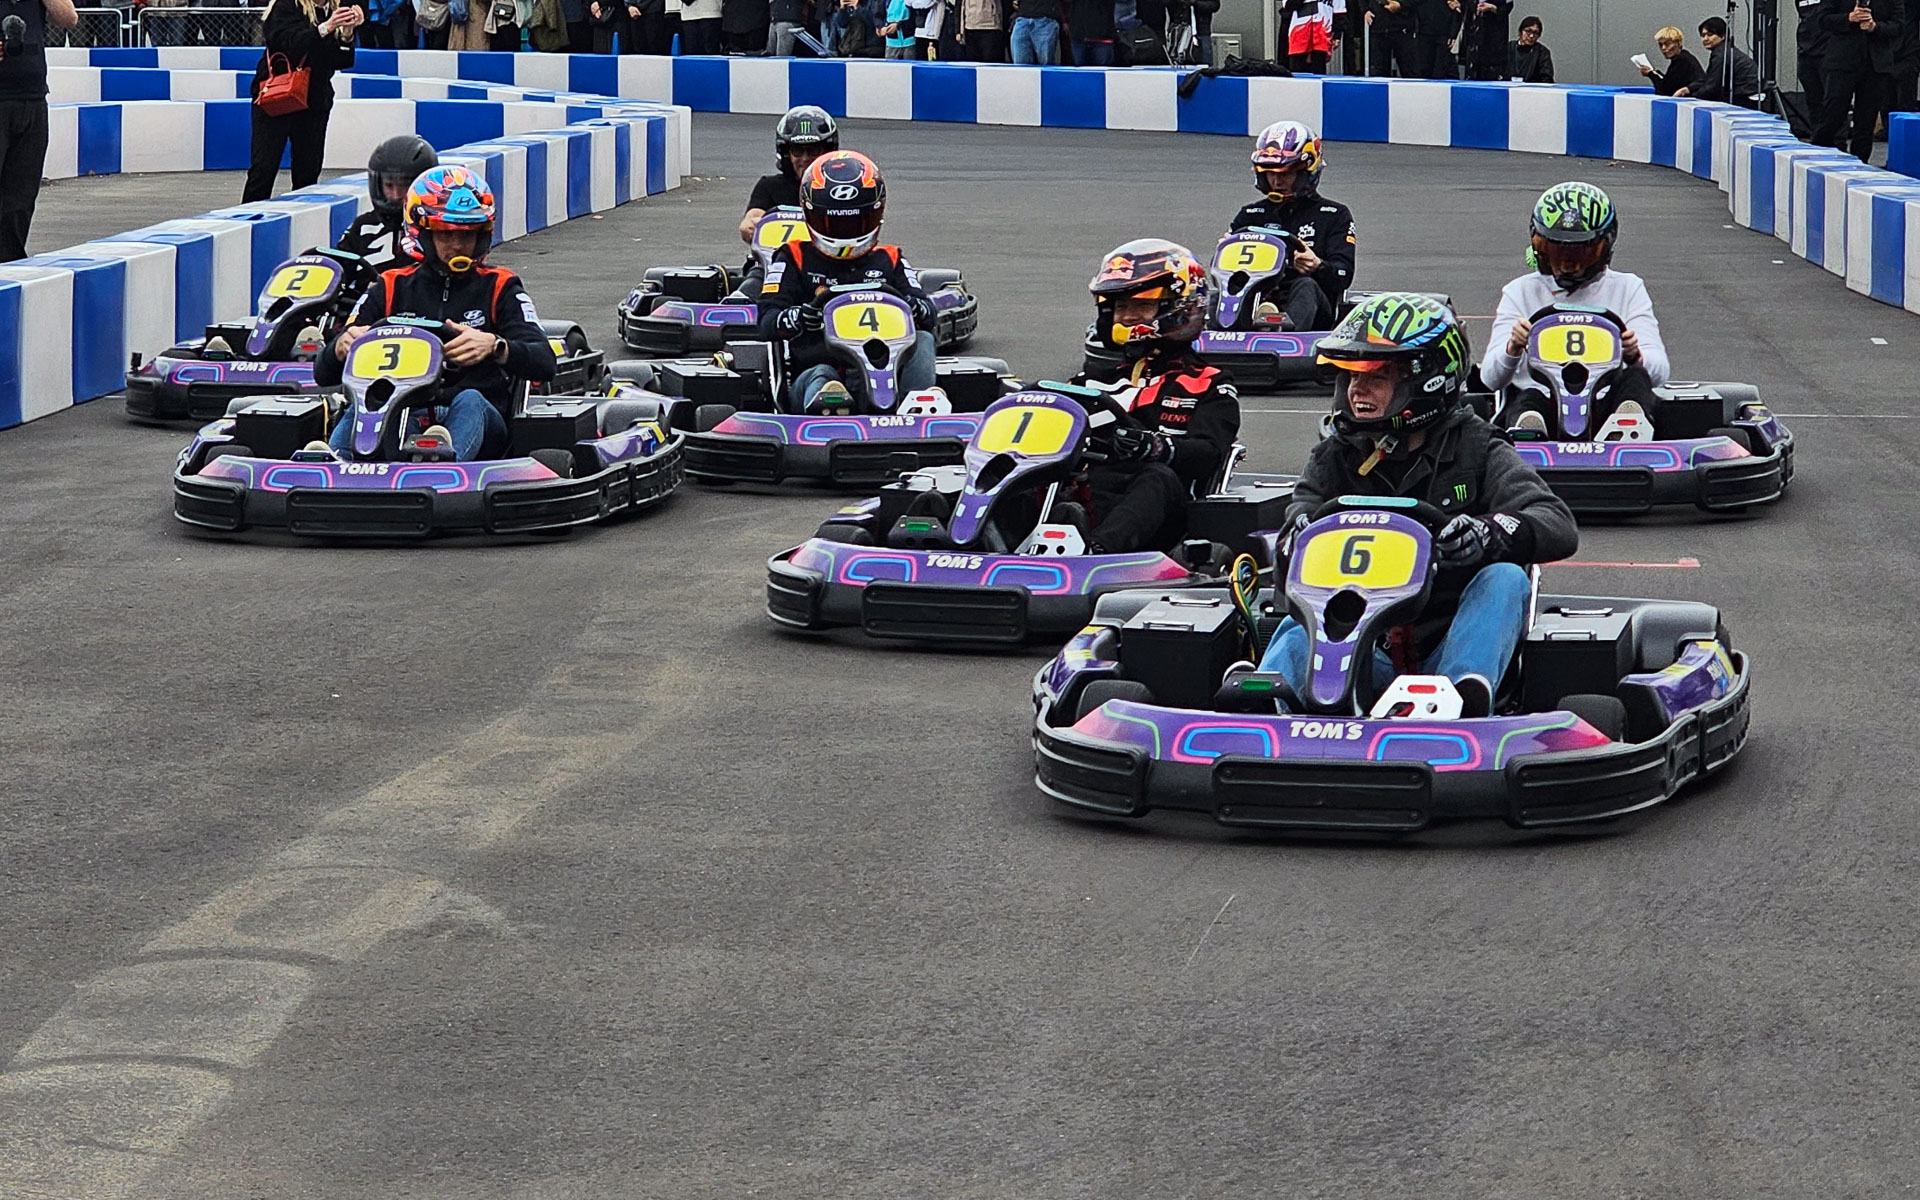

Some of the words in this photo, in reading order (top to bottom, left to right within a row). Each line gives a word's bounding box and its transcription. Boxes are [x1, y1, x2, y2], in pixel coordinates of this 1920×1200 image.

[826, 208, 860, 216] HYUNDAI
[1543, 190, 1602, 231] SPEED
[781, 224, 795, 243] 7
[1239, 233, 1266, 241] TOM'S
[1238, 245, 1257, 265] 5
[286, 269, 309, 291] 2
[850, 293, 883, 302] TOM'S
[858, 307, 879, 332] 4
[1558, 314, 1593, 323] TOM'S
[376, 326, 412, 337] TOM'S
[1208, 331, 1246, 342] TOM'S
[1566, 330, 1586, 356] 8
[378, 344, 401, 371] 3
[230, 361, 269, 372] TOM'S
[1016, 394, 1058, 404] TOM'S
[869, 415, 915, 428] TOM'S
[1160, 412, 1191, 423] DENS
[1011, 412, 1034, 444] 1
[1557, 442, 1605, 454] TOM'S
[339, 463, 389, 475] TOM'S
[1339, 513, 1391, 525] TOM'S
[1340, 535, 1376, 575] 6
[926, 554, 984, 570] TOM'S
[1290, 721, 1364, 741] TOM'S
